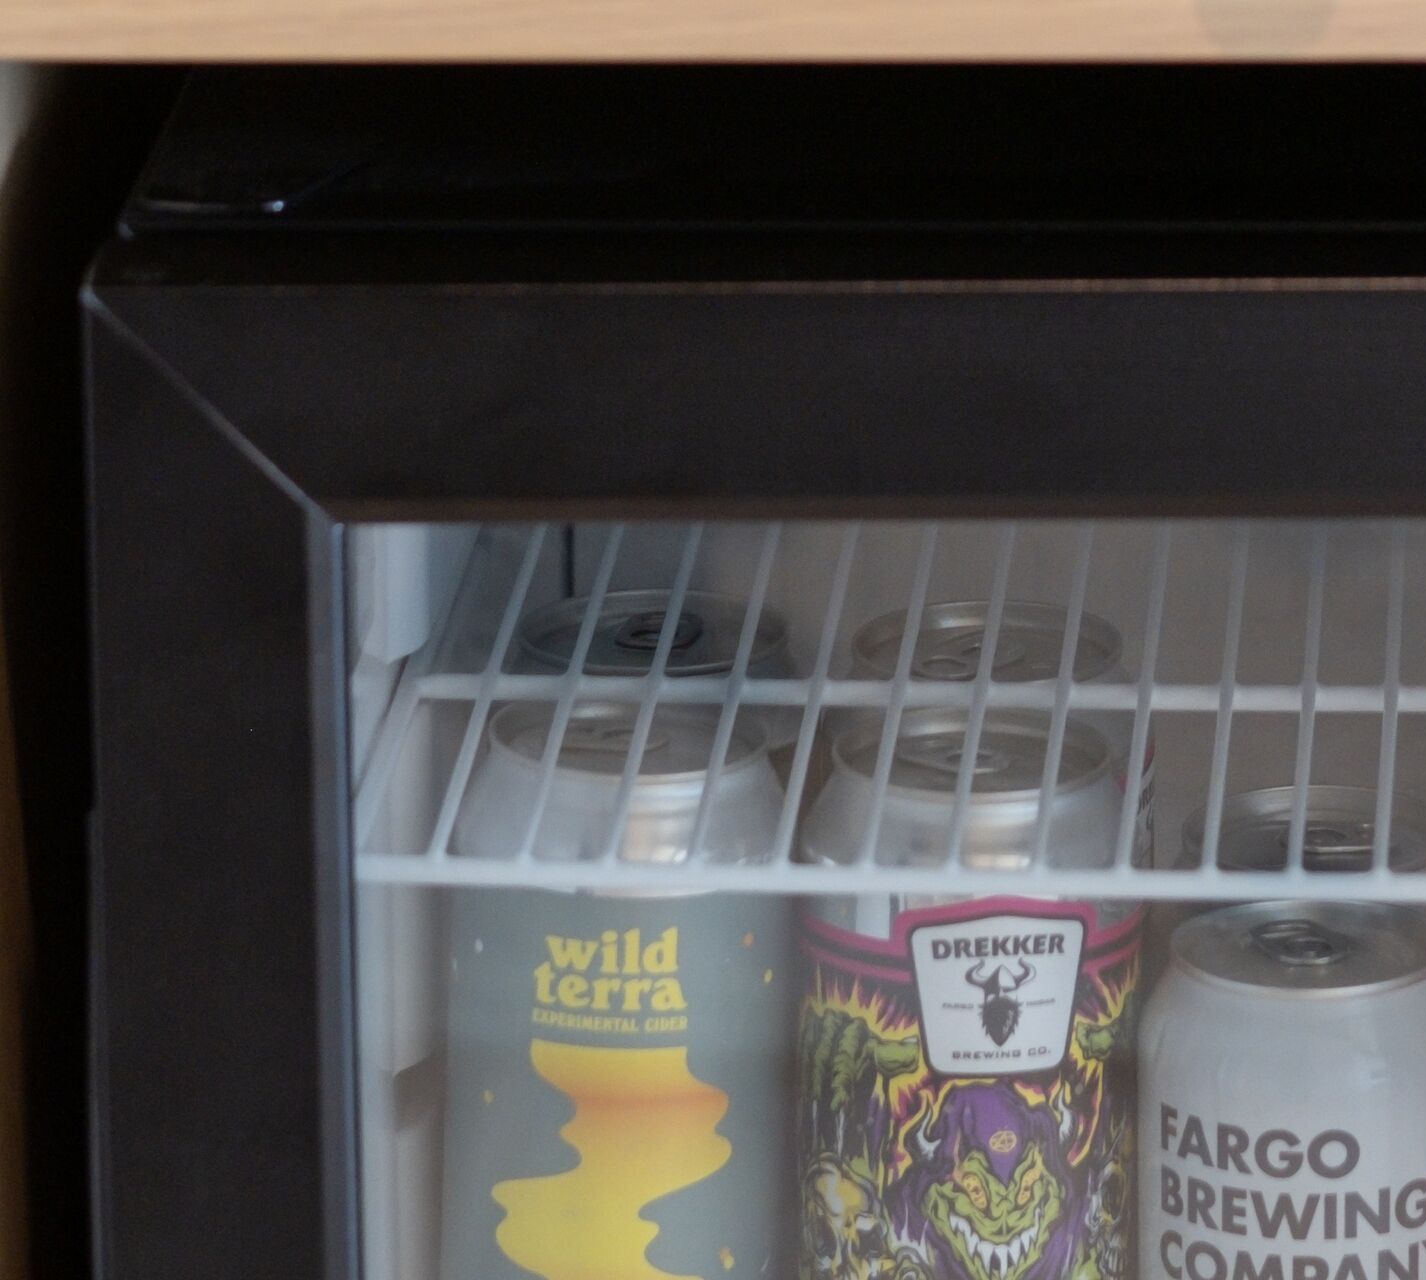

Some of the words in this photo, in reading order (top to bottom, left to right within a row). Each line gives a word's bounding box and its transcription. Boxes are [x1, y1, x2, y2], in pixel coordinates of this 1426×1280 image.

[545, 926, 679, 974] wild
[931, 932, 1066, 960] DREKKER
[533, 959, 689, 1012] terra
[532, 1007, 640, 1033] EXPERIMENTAL
[644, 1015, 689, 1033] CIDER
[952, 1049, 1022, 1060] BREWING
[1027, 1046, 1051, 1057] CO.
[1160, 1102, 1361, 1179] FARGO
